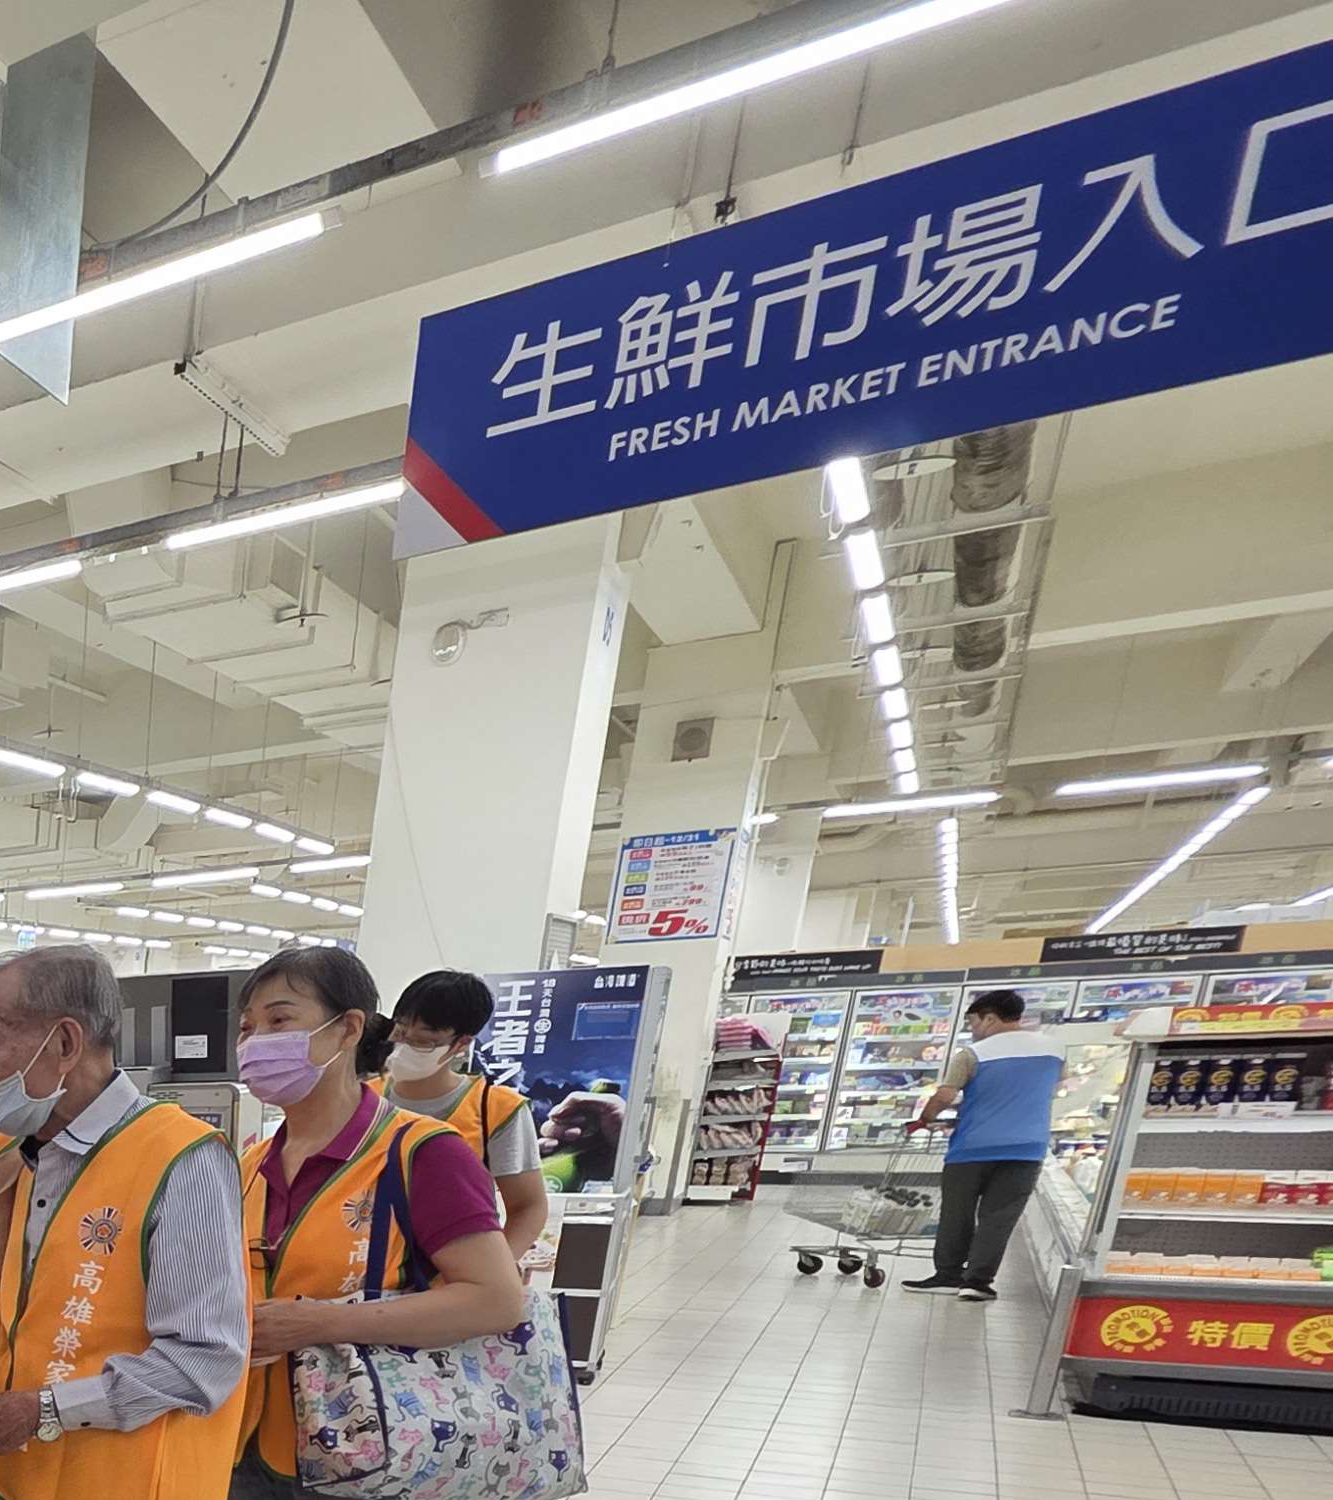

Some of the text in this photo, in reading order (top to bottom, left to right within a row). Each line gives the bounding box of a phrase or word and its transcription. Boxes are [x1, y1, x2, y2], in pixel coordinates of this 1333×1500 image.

[485, 104, 1333, 438] 生鮮市場入口
[608, 294, 1182, 463] FRESH MARKET ENTRANCE
[648, 909, 709, 936] 5%
[43, 1260, 105, 1386] 高雄榮家
[1186, 1319, 1275, 1351] 特價
